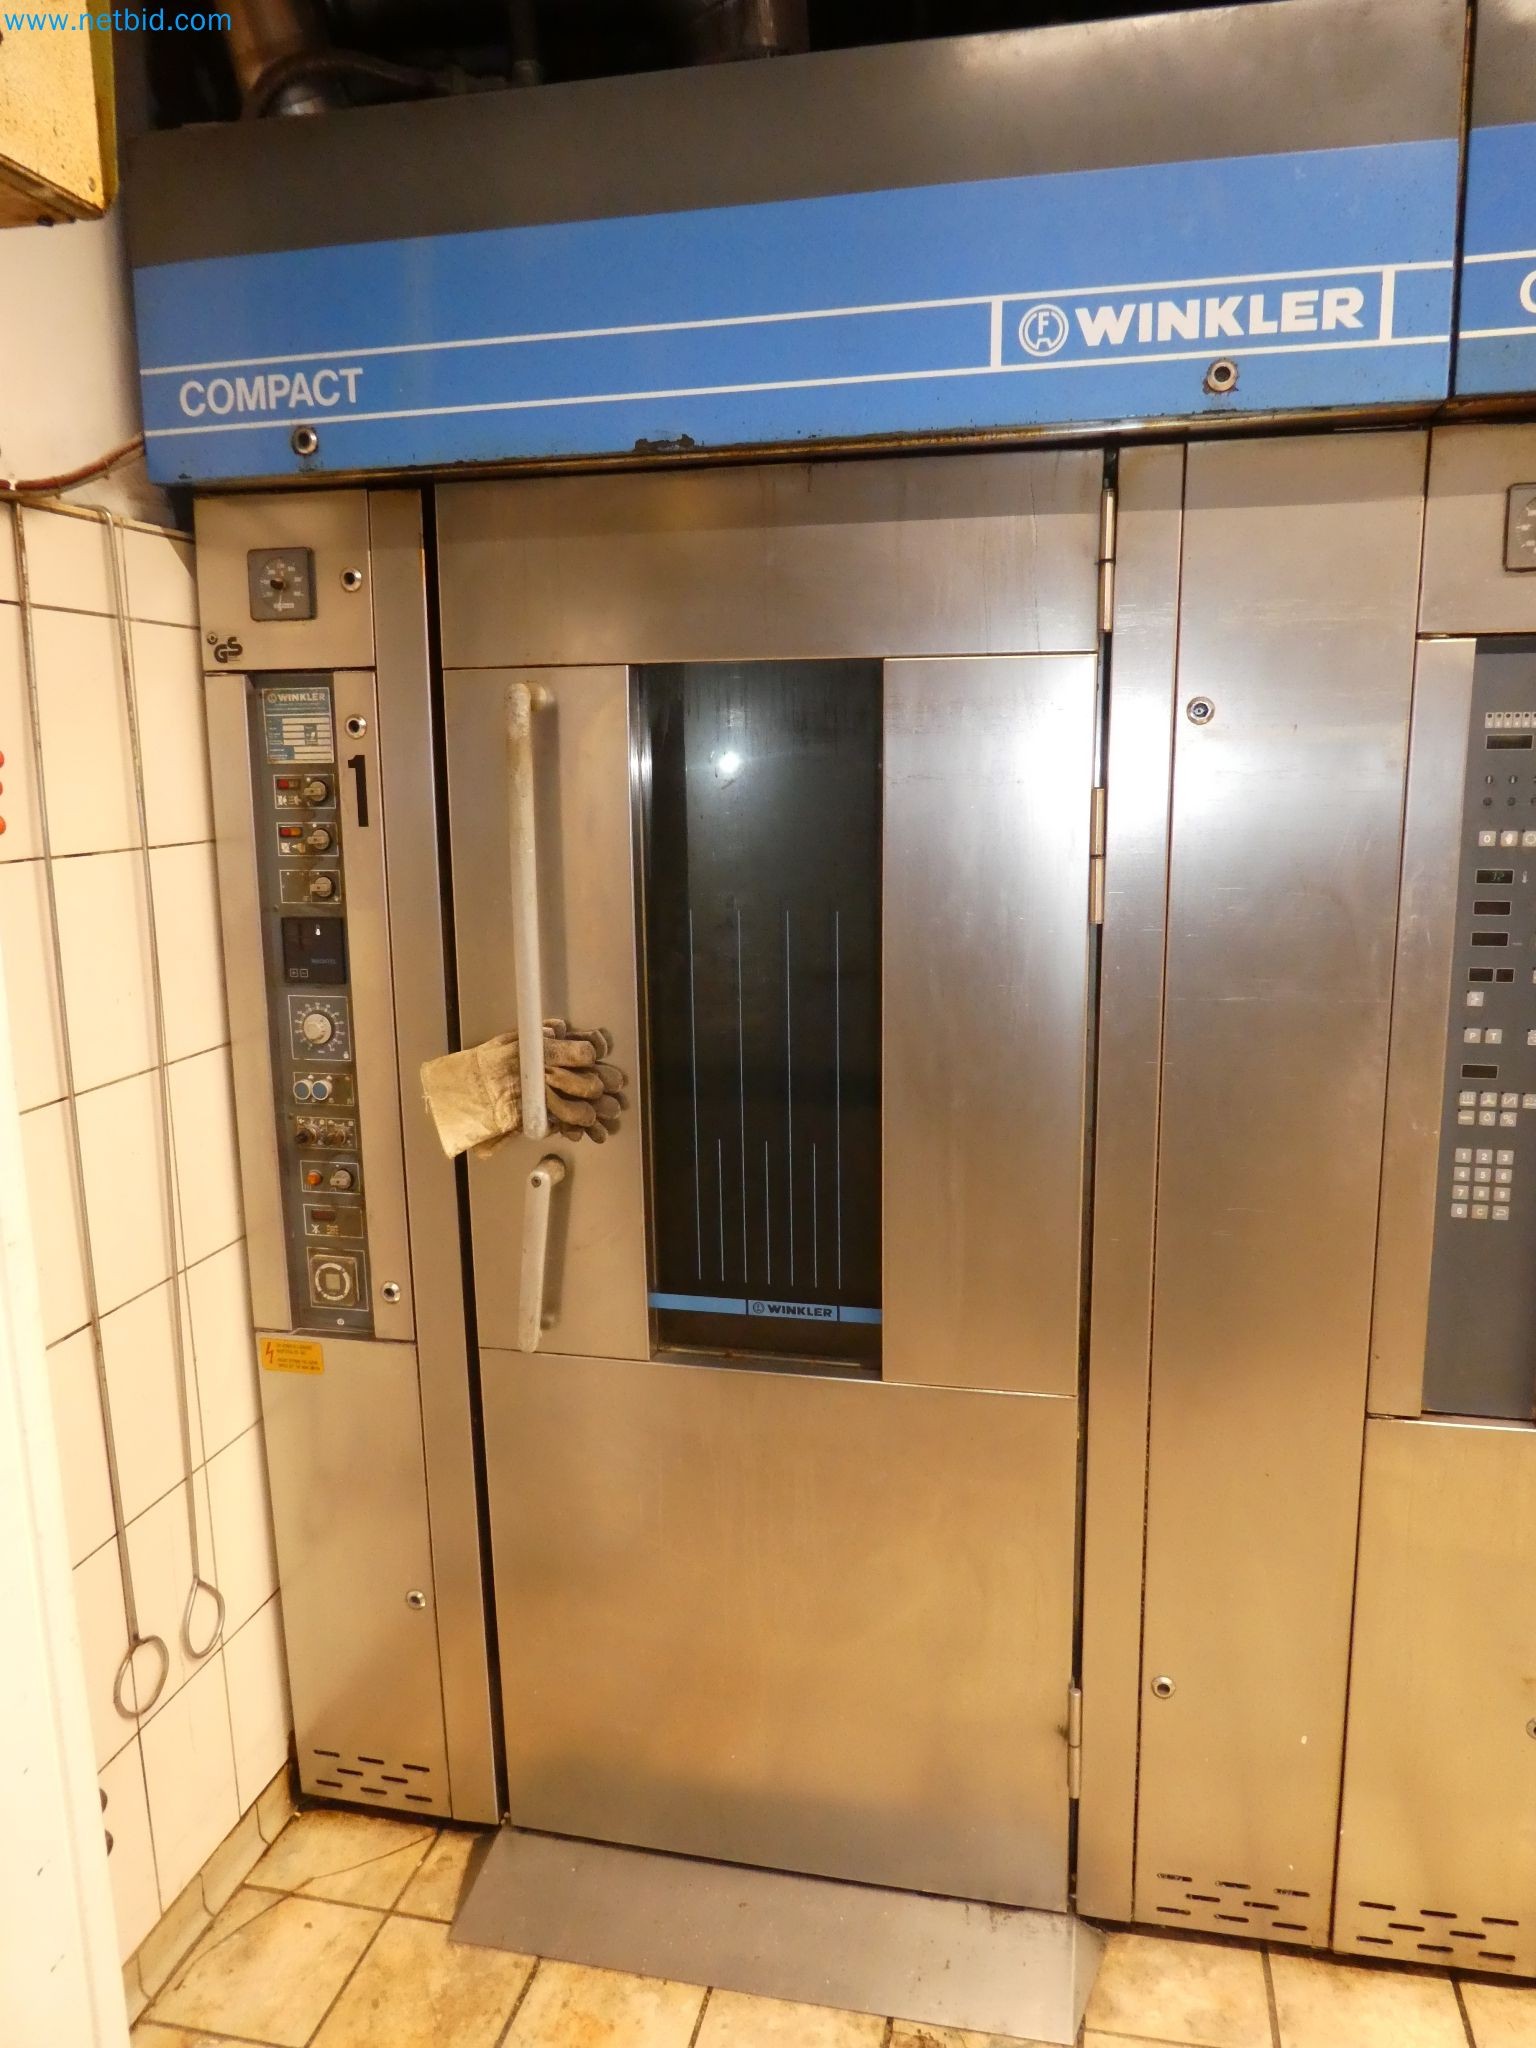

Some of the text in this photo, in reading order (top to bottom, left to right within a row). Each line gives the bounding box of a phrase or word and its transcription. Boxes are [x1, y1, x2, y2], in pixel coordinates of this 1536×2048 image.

[1074, 286, 1365, 348] WINKLER
[178, 366, 364, 419] COMPACT
[277, 691, 326, 702] WINKLER
[347, 754, 369, 828] 1
[1481, 1152, 1488, 1161] 2
[1502, 1154, 1509, 1162] 3
[1480, 1171, 1486, 1179] 5
[767, 1303, 833, 1318] WINKLER
